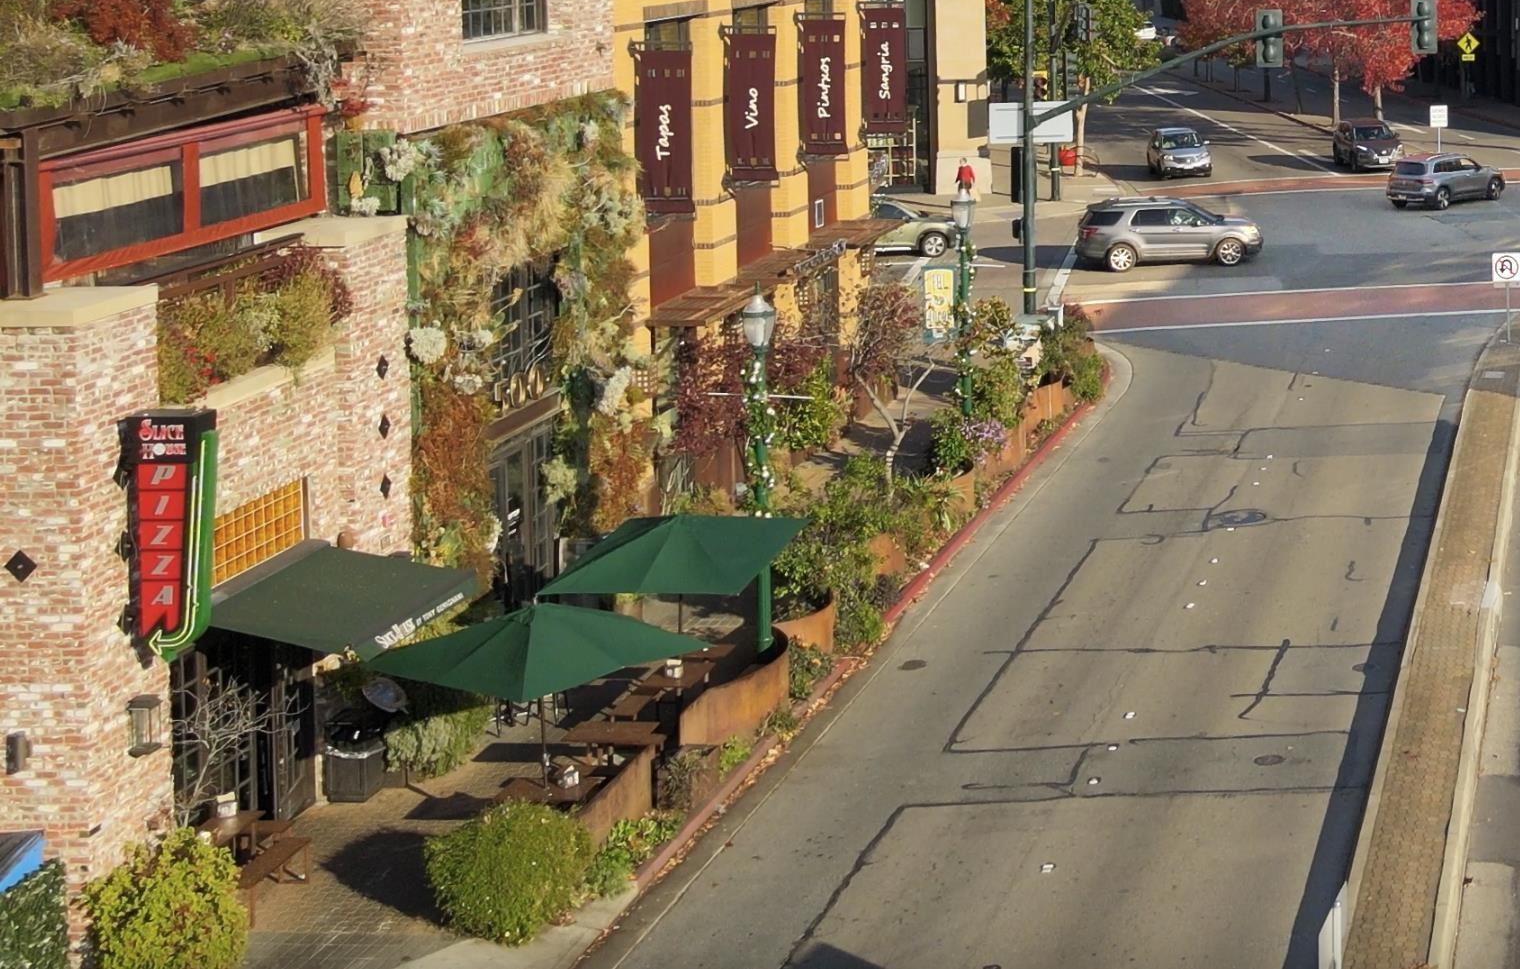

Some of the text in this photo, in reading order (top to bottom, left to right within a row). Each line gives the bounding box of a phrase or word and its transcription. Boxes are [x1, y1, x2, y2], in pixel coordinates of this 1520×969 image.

[817, 56, 831, 119] Pintxos
[878, 40, 893, 100] Sangria
[655, 103, 672, 161] Tapas
[744, 87, 759, 130] Vino
[150, 464, 177, 606] PIZZA
